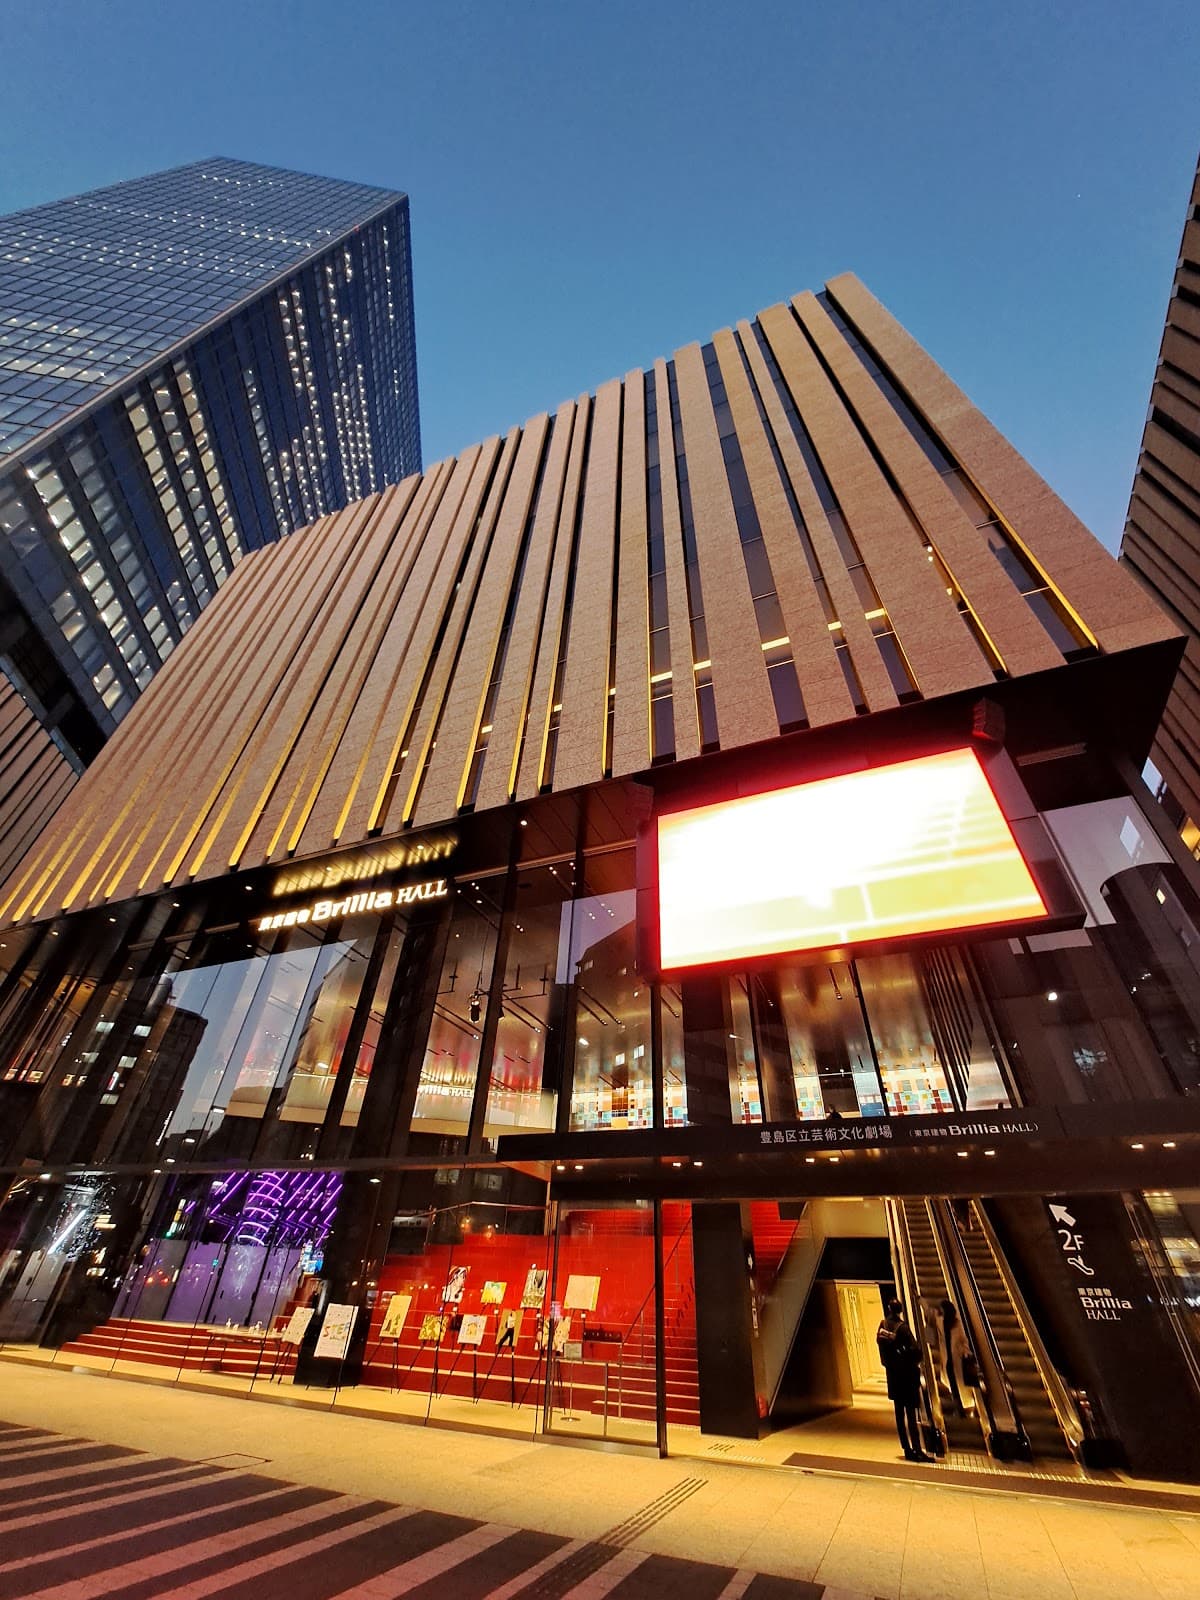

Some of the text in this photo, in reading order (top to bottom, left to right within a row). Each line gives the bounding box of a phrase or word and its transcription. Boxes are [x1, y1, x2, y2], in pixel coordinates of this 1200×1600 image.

[312, 891, 393, 921] Brillia
[395, 880, 448, 904] HALL
[760, 1124, 893, 1144] 豊島区立芸術文化劇場
[948, 1123, 1001, 1136] Brillia
[1058, 1229, 1084, 1250] 2F
[1080, 1296, 1133, 1309] Brillia
[1086, 1309, 1121, 1320] HALL
